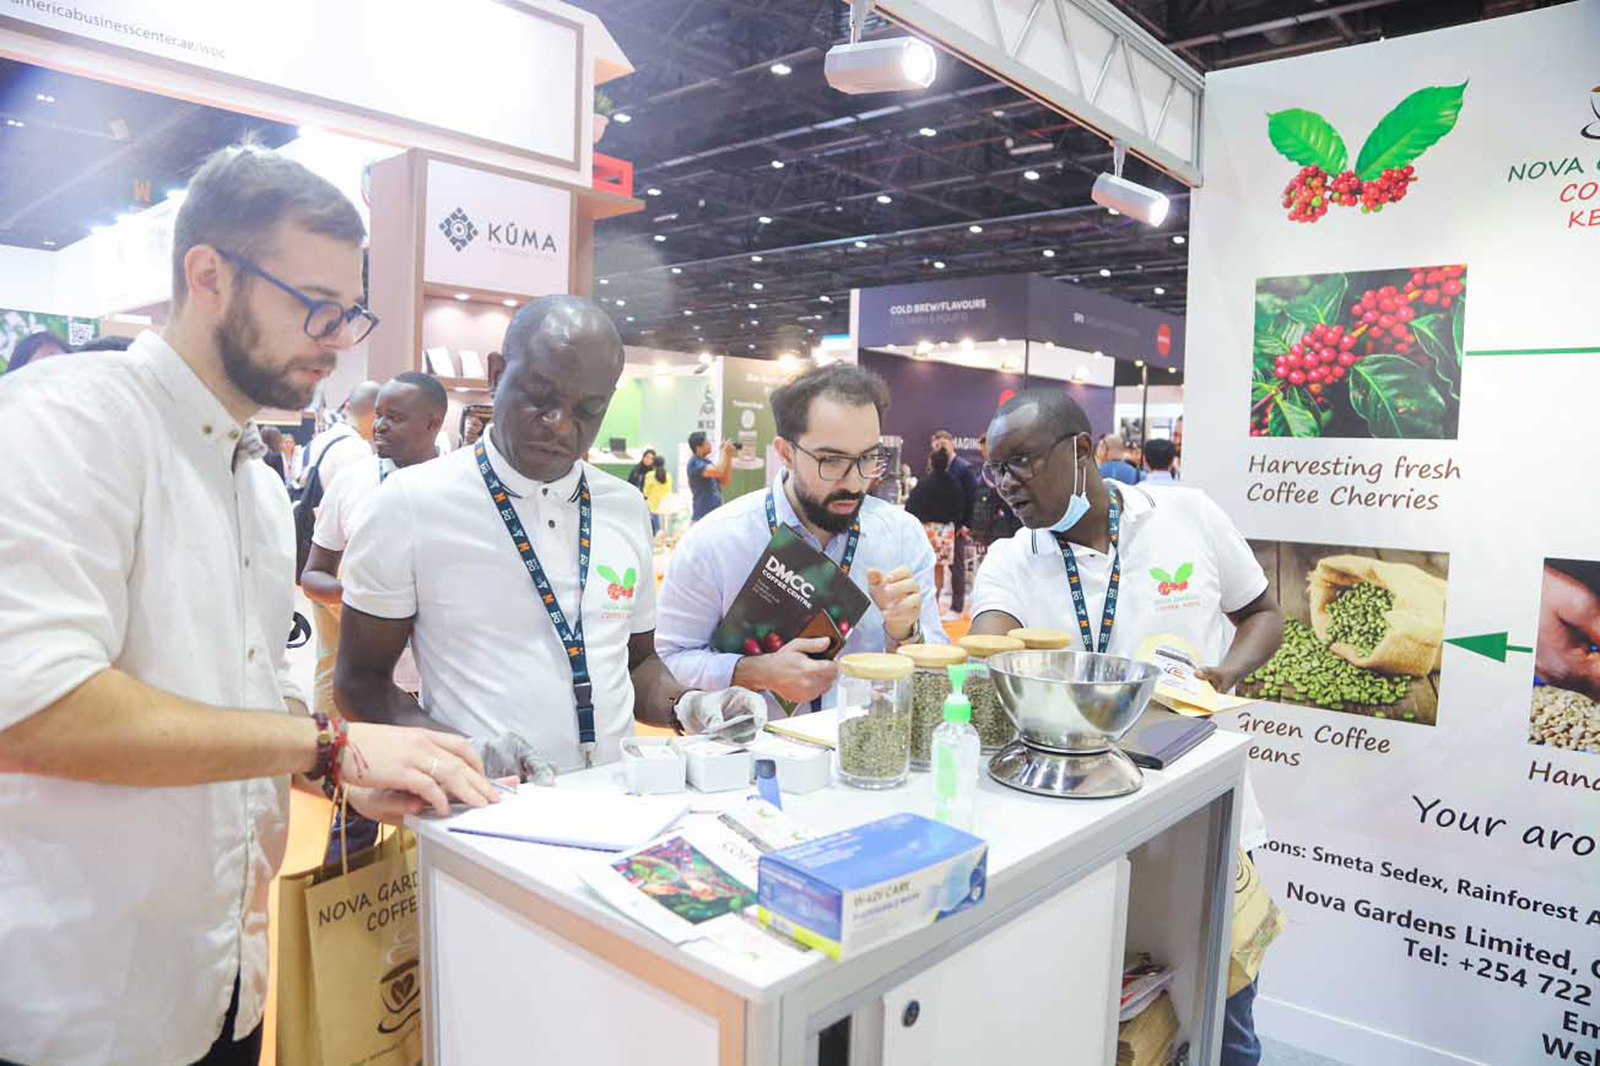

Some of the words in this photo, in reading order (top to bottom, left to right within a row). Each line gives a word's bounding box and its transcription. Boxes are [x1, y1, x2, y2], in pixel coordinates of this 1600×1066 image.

[1507, 157, 1584, 182] NOVA
[889, 305, 913, 315] COLD
[1248, 455, 1383, 484] Harvesting
[1394, 456, 1461, 480] fresh
[1246, 482, 1319, 504] Coffee
[1330, 486, 1439, 510] Cherries
[762, 569, 787, 591] COFFEE
[786, 587, 813, 610] CENTRE
[765, 555, 815, 599] DMCC
[1248, 745, 1300, 767] eans
[1314, 725, 1391, 754] Coffee
[1412, 795, 1507, 837] Your
[1522, 825, 1596, 856] aro
[1312, 846, 1374, 875] Smeta
[1380, 862, 1449, 893] Sedex,
[1457, 879, 1579, 922] Rainforest
[318, 892, 373, 927] NOVA
[1286, 881, 1346, 912] Nova
[1353, 899, 1456, 940] Gardens
[1466, 926, 1579, 976] Limited,
[1403, 937, 1449, 967] Tel:
[1460, 956, 1528, 989] +254
[1538, 973, 1593, 1007] 722
